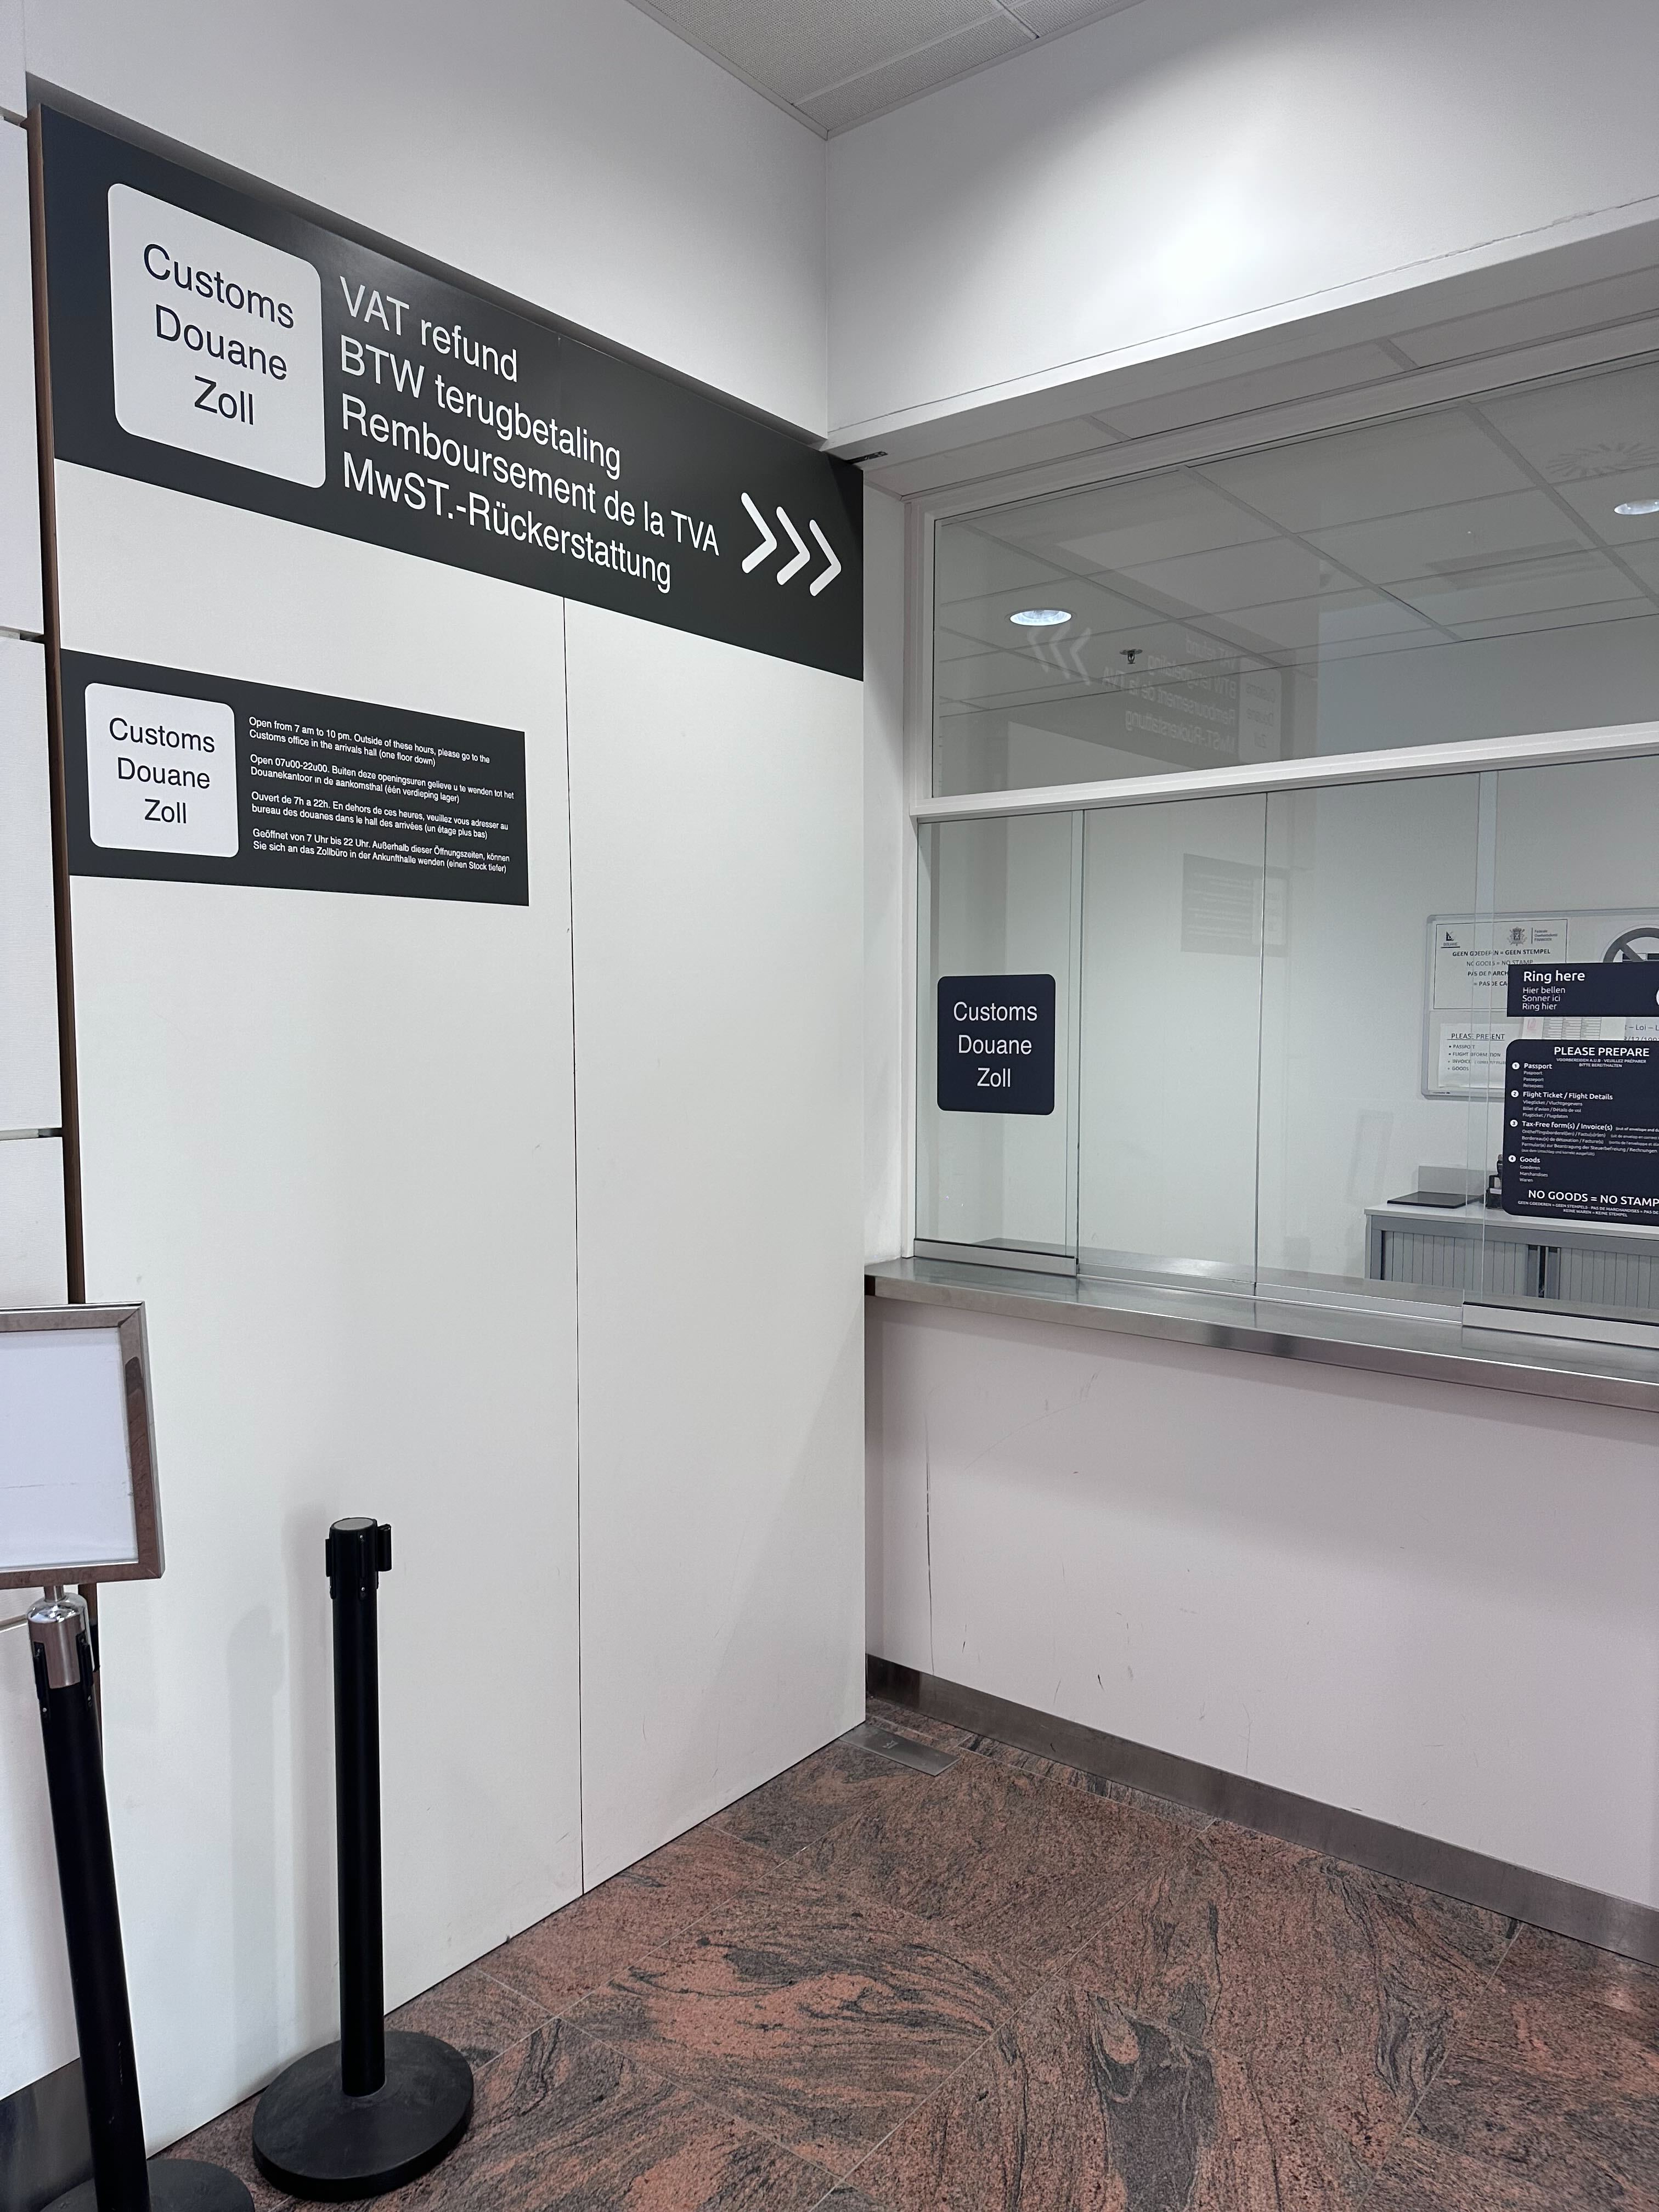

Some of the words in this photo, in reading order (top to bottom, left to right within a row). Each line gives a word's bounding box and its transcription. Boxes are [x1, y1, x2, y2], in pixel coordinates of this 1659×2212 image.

[144, 244, 294, 329] Customs
[156, 304, 287, 380] Douane
[339, 275, 410, 336] VAT
[421, 319, 517, 382] refund
[194, 375, 255, 425] Zoll
[341, 334, 425, 398] BTW
[435, 374, 620, 480] terugbetaling
[342, 393, 596, 514] Remboursement
[604, 490, 635, 526] de
[644, 500, 665, 538] la
[670, 510, 719, 556] TVA
[343, 451, 670, 594] MwST.-Rückerstattung
[109, 718, 215, 753] Customs
[249, 716, 272, 729] Open
[273, 720, 292, 732] from
[294, 724, 300, 733] 7
[301, 726, 314, 735] am
[315, 727, 324, 736] to
[326, 729, 336, 738] 10
[337, 732, 352, 741] pm.
[354, 733, 383, 746] Outside
[384, 739, 392, 747] of
[393, 740, 413, 751] these
[414, 743, 436, 756] hours,
[437, 748, 460, 759] please
[461, 753, 470, 761] go
[471, 753, 478, 761] to
[479, 754, 490, 764] the
[249, 729, 286, 743] Customs
[287, 735, 309, 746] office
[311, 738, 319, 748] in
[320, 740, 333, 750] the
[334, 743, 363, 754] arrivals
[364, 746, 377, 757] hall
[379, 749, 396, 759] (one
[397, 752, 413, 762] floor
[414, 755, 436, 768] down)
[117, 757, 211, 789] Douane
[250, 754, 273, 766] Open
[275, 757, 330, 773] 07u00-22u00.
[331, 765, 356, 777] Buiten
[358, 769, 376, 780] deze
[377, 774, 426, 787] openingsuren
[427, 780, 452, 791] gelieve
[459, 784, 466, 793] te
[467, 786, 493, 797] wenden
[494, 789, 503, 798] tot
[504, 790, 515, 799] het
[251, 766, 313, 783] Douanekantoor
[323, 776, 334, 786] de
[335, 779, 383, 792] aankomsthal
[385, 784, 401, 795] (één
[402, 788, 439, 802] verdieping
[440, 792, 460, 804] lager)
[144, 798, 188, 825] Zoll
[251, 791, 280, 803] Ouvert
[281, 794, 292, 804] de
[294, 796, 304, 806] 7h
[313, 798, 331, 809] 22h.
[332, 800, 343, 810] En
[345, 803, 371, 814] dehors
[373, 806, 382, 815] de
[383, 809, 397, 817] ces
[398, 809, 425, 821] heures,
[426, 814, 453, 823] veuillez
[453, 817, 470, 826] vous
[471, 819, 499, 829] adresser
[251, 803, 281, 815] bureau
[283, 807, 298, 817] des
[299, 809, 334, 821] douanes
[335, 813, 354, 823] dans
[356, 815, 363, 824] le
[364, 816, 378, 826] hall
[379, 818, 393, 828] des
[394, 821, 423, 831] arrivées
[424, 823, 436, 833] (un
[437, 825, 456, 837] étage
[458, 828, 472, 837] plus
[473, 829, 488, 840] bas)
[252, 828, 289, 840] Geöffnet
[289, 833, 305, 842] von
[306, 833, 312, 842] 7
[314, 834, 329, 844] Uhr
[330, 836, 342, 845] bis
[343, 837, 353, 847] 22
[355, 838, 371, 848] Uhr.
[372, 840, 409, 852] Außerhalb
[410, 844, 433, 854] dieser
[433, 845, 485, 861] Öffnungszeiten,
[487, 852, 510, 862] können
[253, 840, 267, 850] Sie
[269, 842, 286, 852] sich
[300, 845, 315, 855] das
[316, 846, 348, 857] Zollbüro
[349, 849, 357, 859] in
[358, 850, 371, 860] der
[372, 851, 416, 864] Ankunfthalle
[417, 857, 445, 867] wenden
[447, 859, 467, 869] (einen
[469, 861, 487, 871] Stock
[488, 863, 506, 874] tiefer)
[1523, 970, 1552, 984] Ring
[1555, 969, 1585, 981] here
[1541, 986, 1566, 994] bellen
[953, 1001, 1037, 1022] Customs
[1522, 1003, 1540, 1012] Ring
[958, 1035, 1032, 1055] Douane
[1554, 1046, 1595, 1056] PLEASE
[1598, 1047, 1650, 1057] PREPARE
[977, 1068, 1011, 1087] Zoll
[1523, 1091, 1542, 1099] Flight
[1551, 1121, 1575, 1130] form(s)
[1581, 1123, 1613, 1132] Invoice(s)
[1528, 1189, 1545, 1199] NO
[1548, 1191, 1588, 1202] GOODS
[1600, 1194, 1618, 1204] NO
[1620, 1196, 1659, 1207] STAMP
